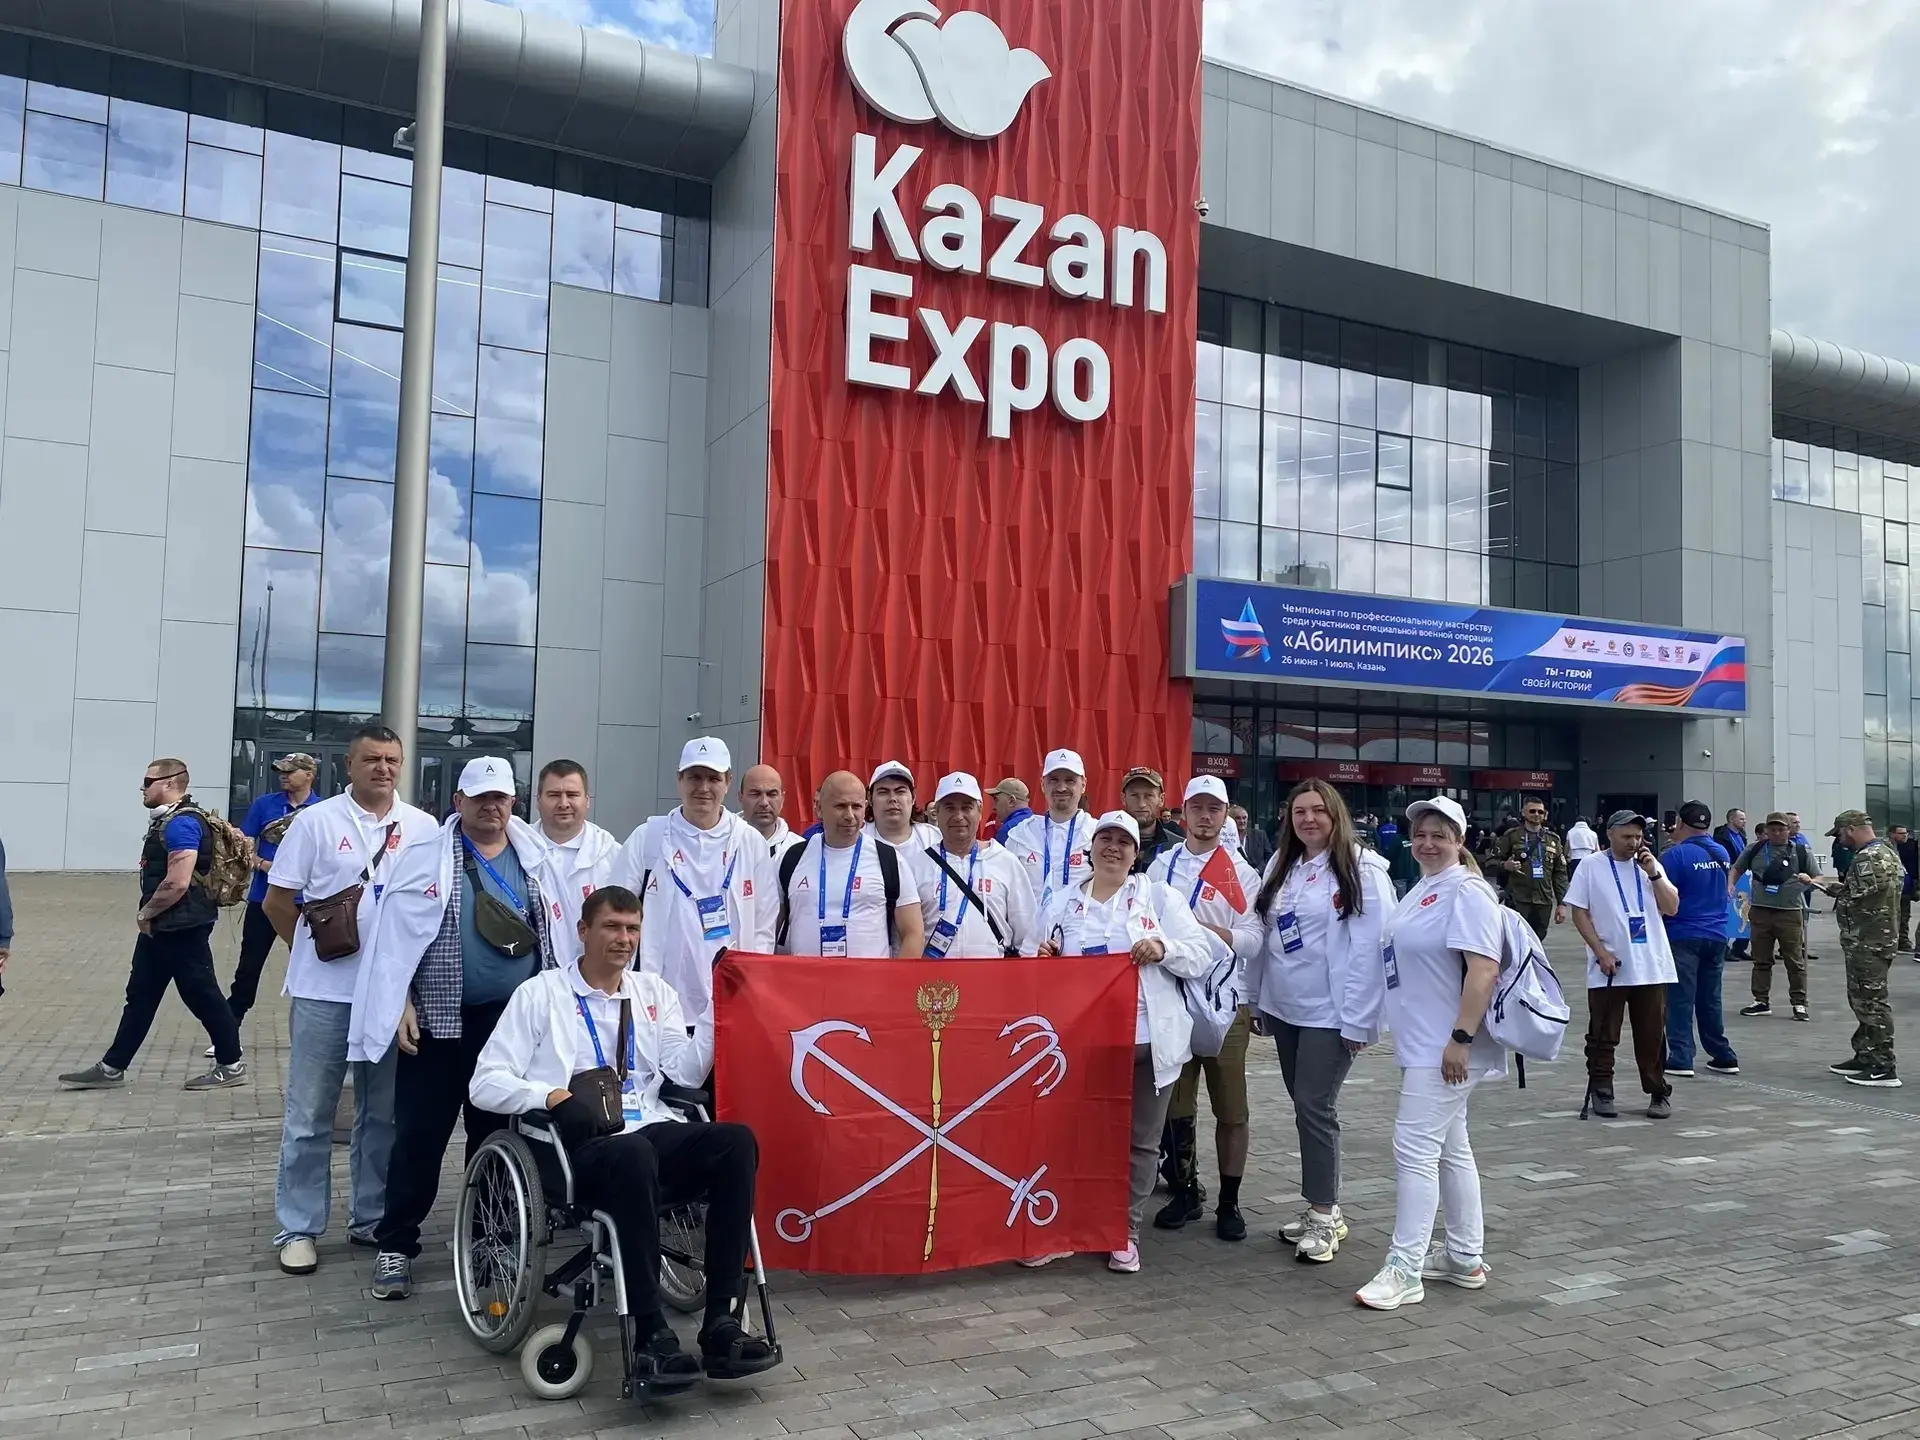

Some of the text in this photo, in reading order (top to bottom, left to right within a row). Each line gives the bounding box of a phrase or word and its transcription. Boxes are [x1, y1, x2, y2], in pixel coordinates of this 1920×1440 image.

[848, 131, 1168, 314] Kazan
[845, 263, 1111, 439] Expo
[1282, 603, 1493, 633] Чемпионат по профессиональному мастерству
[1282, 616, 1493, 643] среди участников специальной военной операции
[1282, 630, 1494, 666] «Абилимпикс» 2026
[1281, 655, 1293, 665] 26
[1294, 657, 1318, 666] июня
[1330, 660, 1355, 671] июля,
[1357, 662, 1387, 672] Казань
[1545, 667, 1558, 677] ТЫ
[1565, 667, 1592, 679] ГЕРОЙ
[1521, 677, 1592, 692] СВОЕЙ ИСТОРИИ!
[1207, 757, 1229, 767] ВХОД
[1339, 763, 1360, 773] ВХОД
[1422, 767, 1442, 777] ВХОД
[1531, 772, 1549, 782] ВХОД
